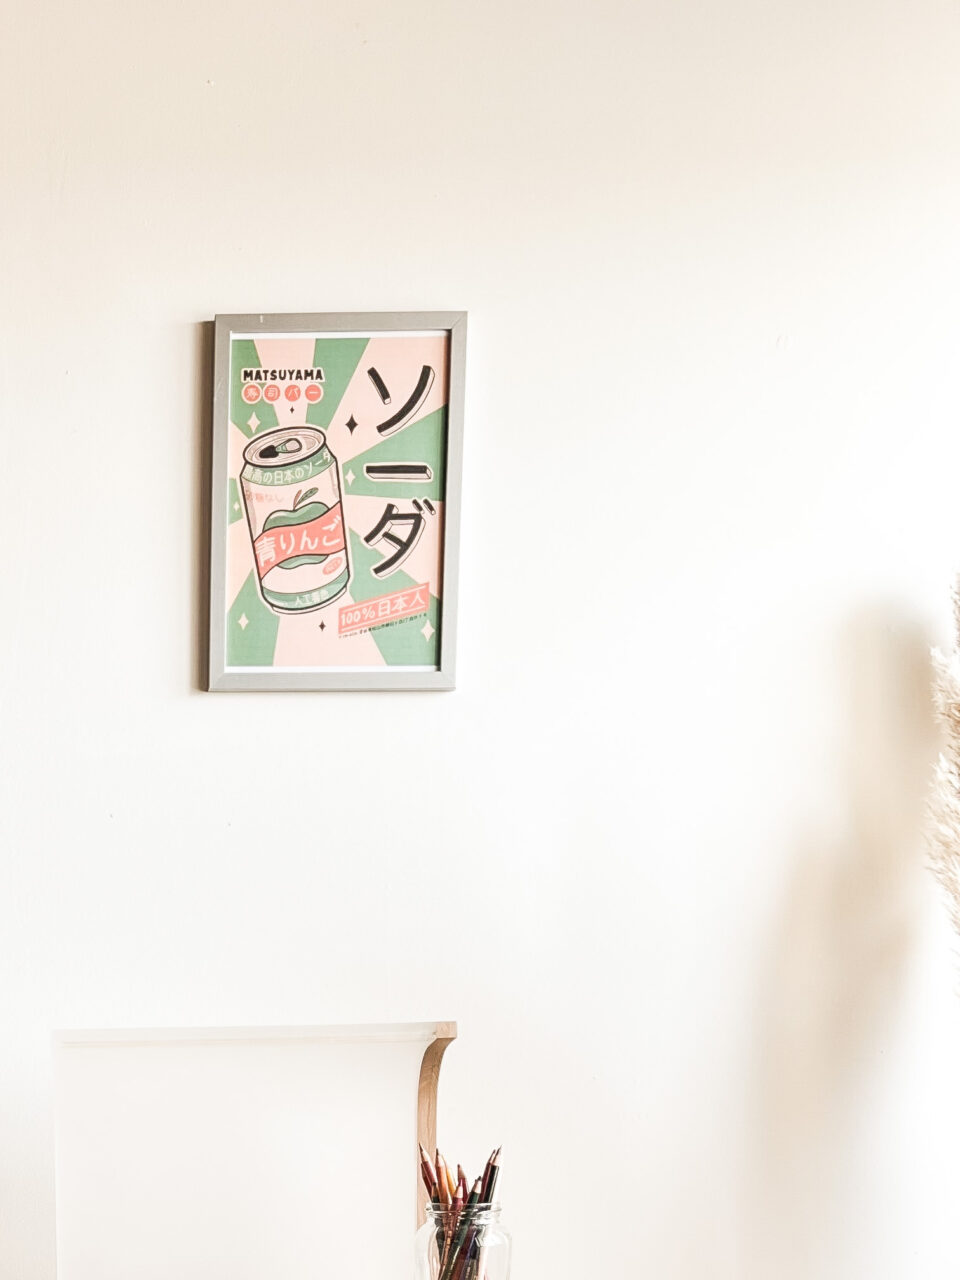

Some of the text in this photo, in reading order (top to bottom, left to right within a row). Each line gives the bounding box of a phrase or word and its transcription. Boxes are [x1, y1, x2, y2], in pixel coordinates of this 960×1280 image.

[243, 369, 323, 381] MATSUYAMA
[363, 365, 435, 577] ソーダ
[256, 514, 341, 567] 青りんご
[341, 592, 426, 626] 100%日本人
